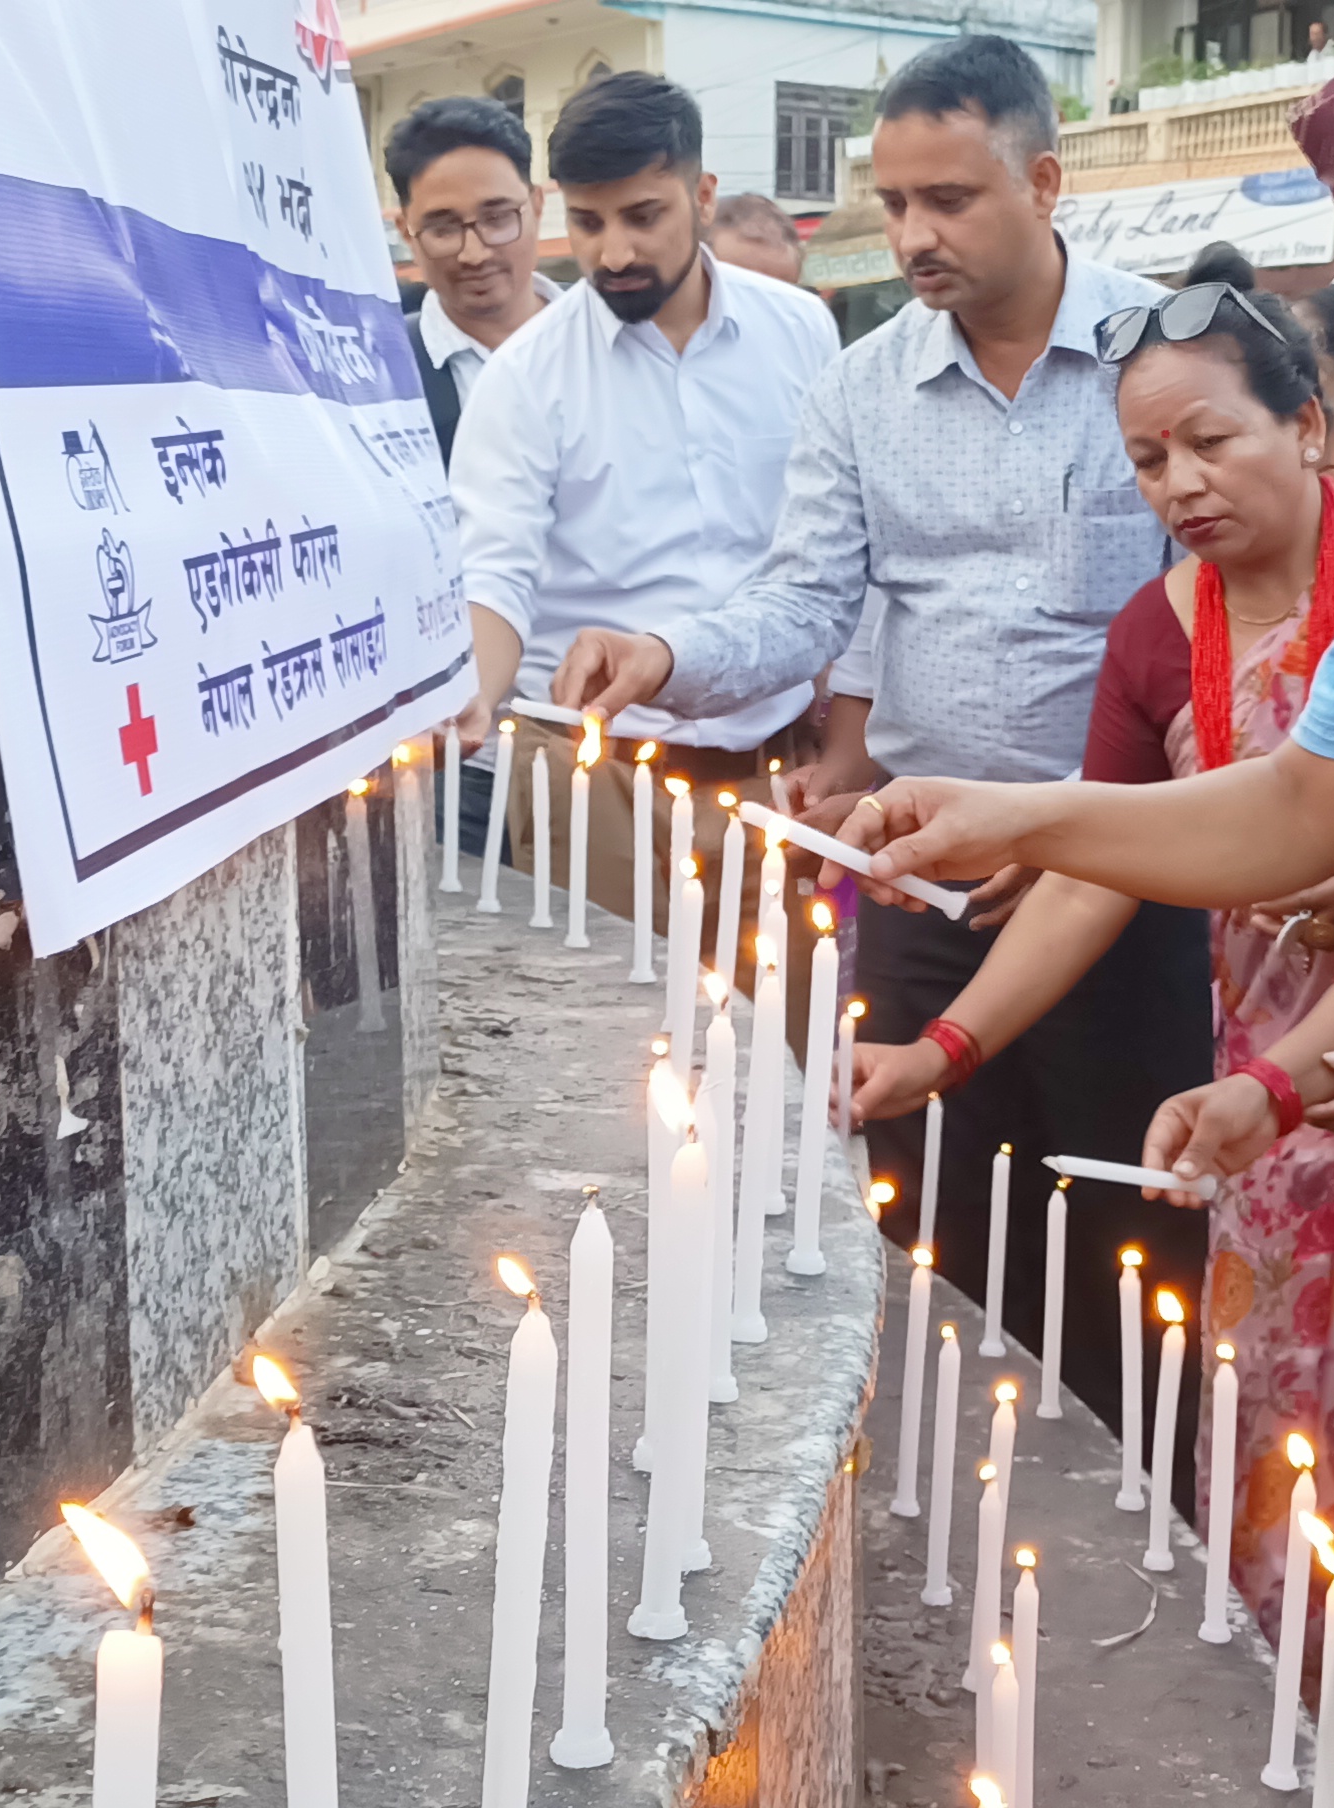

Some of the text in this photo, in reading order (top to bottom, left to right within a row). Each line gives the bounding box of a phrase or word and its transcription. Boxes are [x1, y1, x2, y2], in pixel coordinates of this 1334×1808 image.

[1124, 188, 1236, 240] Land
[289, 514, 342, 589] फोरम
[197, 661, 256, 737] नेपाल
[328, 596, 387, 690] सोसाइटी
